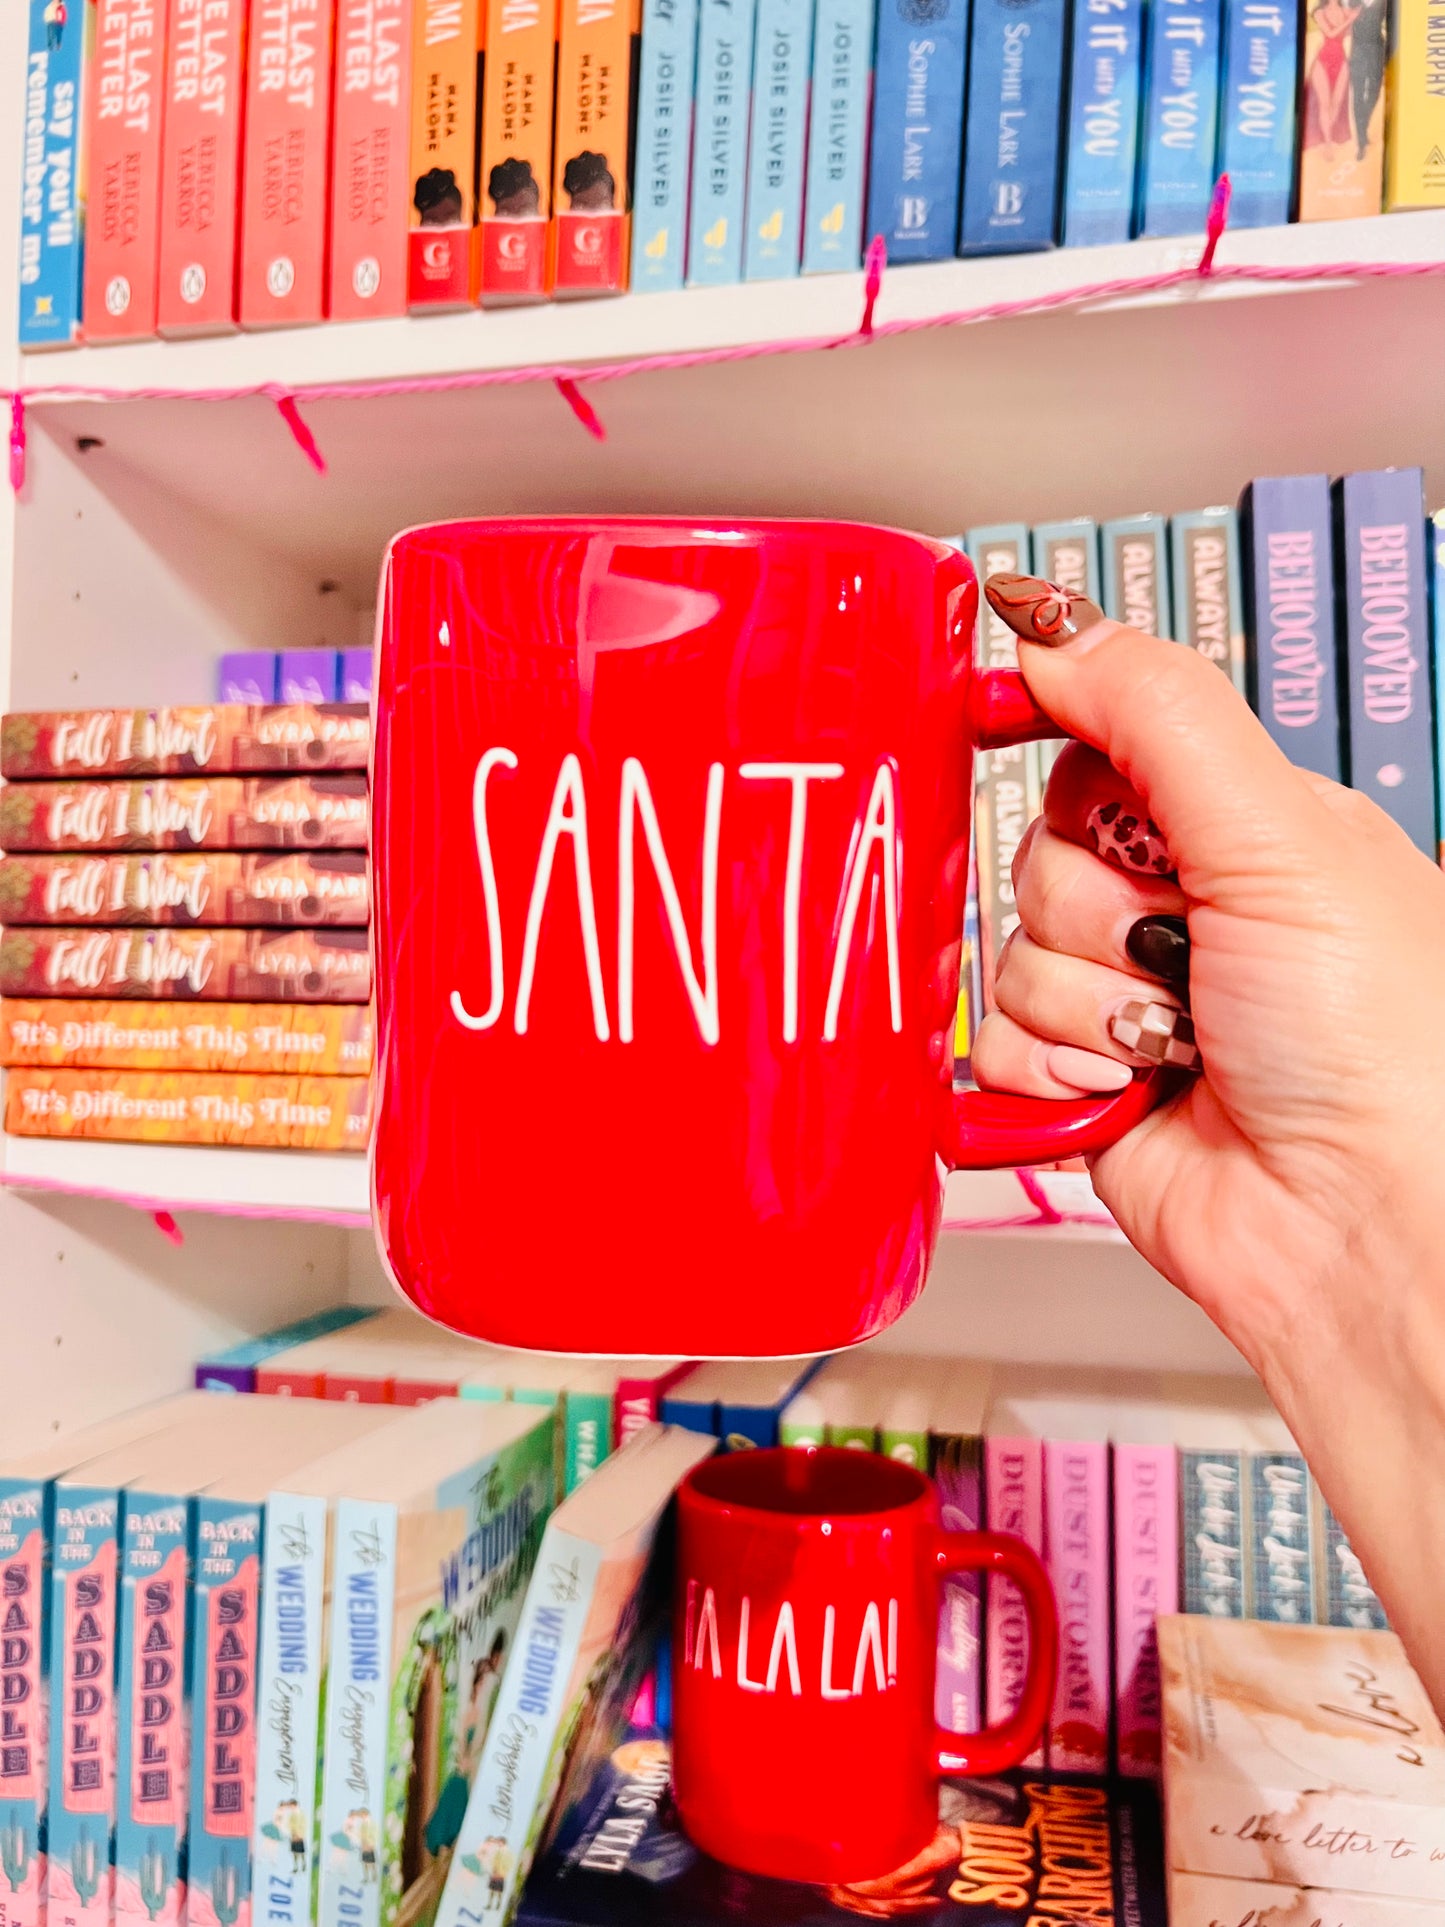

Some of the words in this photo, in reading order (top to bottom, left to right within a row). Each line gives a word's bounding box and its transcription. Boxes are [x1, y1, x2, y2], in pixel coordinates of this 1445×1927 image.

[1088, 24, 1128, 55] IT
[1164, 17, 1205, 47] IT
[1242, 5, 1284, 36] IT
[200, 29, 228, 116] LAST
[286, 20, 316, 108] LAST
[371, 18, 401, 108] LAST
[655, 52, 675, 117] JOSIE
[714, 39, 734, 106] JOSIE
[771, 29, 791, 96] JOSIE
[832, 22, 851, 88] JOSIE
[124, 48, 152, 133] LAST
[1160, 91, 1199, 149] YOU
[1237, 80, 1277, 139] YOU
[710, 115, 730, 196] SILVER
[766, 106, 787, 189] SILVER
[827, 98, 848, 181] SILVER
[1083, 99, 1122, 156] YOU
[652, 127, 671, 207] SILVER
[1193, 535, 1228, 660] ALWAYS
[1267, 529, 1327, 728] BEHOOVED
[1359, 523, 1419, 724] BEHOOVED
[52, 711, 114, 767] Fall
[258, 721, 315, 745] LYRA
[48, 786, 110, 842] Fall
[255, 801, 311, 824] LYRA
[46, 859, 107, 915] Fall
[253, 876, 309, 899] LYRA
[450, 746, 902, 1046] SANTA
[46, 931, 111, 988] Fall
[256, 952, 312, 975] LYRA
[12, 1021, 58, 1048] It's
[61, 1022, 181, 1051] Different
[181, 1024, 248, 1058] This
[253, 1025, 327, 1055] Time
[22, 1089, 67, 1116] It's
[70, 1090, 188, 1122] Different
[191, 1095, 254, 1129] This
[259, 1097, 332, 1127] Time
[57, 1507, 113, 1528] BACK
[127, 1513, 184, 1534] BACK
[1002, 1453, 1026, 1537] DUS
[1063, 1457, 1089, 1560] DUST
[1132, 1462, 1158, 1565] DUST
[67, 1527, 86, 1545] IN
[137, 1534, 155, 1551] IN
[201, 1520, 257, 1542] BACK
[210, 1541, 228, 1559] IN
[276, 1565, 308, 1674] WEDDING
[347, 1570, 381, 1682] WEDDING
[737, 1596, 802, 1697] LA
[1064, 1569, 1091, 1711] STORM
[1, 1563, 31, 1778] SADDLE
[72, 1574, 104, 1792] SADDLE
[139, 1580, 174, 1803] SADDLE
[517, 1605, 566, 1716] WEDDING
[212, 1589, 248, 1815] SADDLE
[269, 1677, 303, 1794] Engagement
[339, 1684, 376, 1802] Engagement
[579, 1817, 649, 1873] LYLA
[948, 1820, 1035, 1909] SOUL
[1234, 1815, 1289, 1843] love
[1303, 1822, 1380, 1855] letter
[1384, 1838, 1417, 1859] to
[268, 1875, 293, 1922] ZOE
